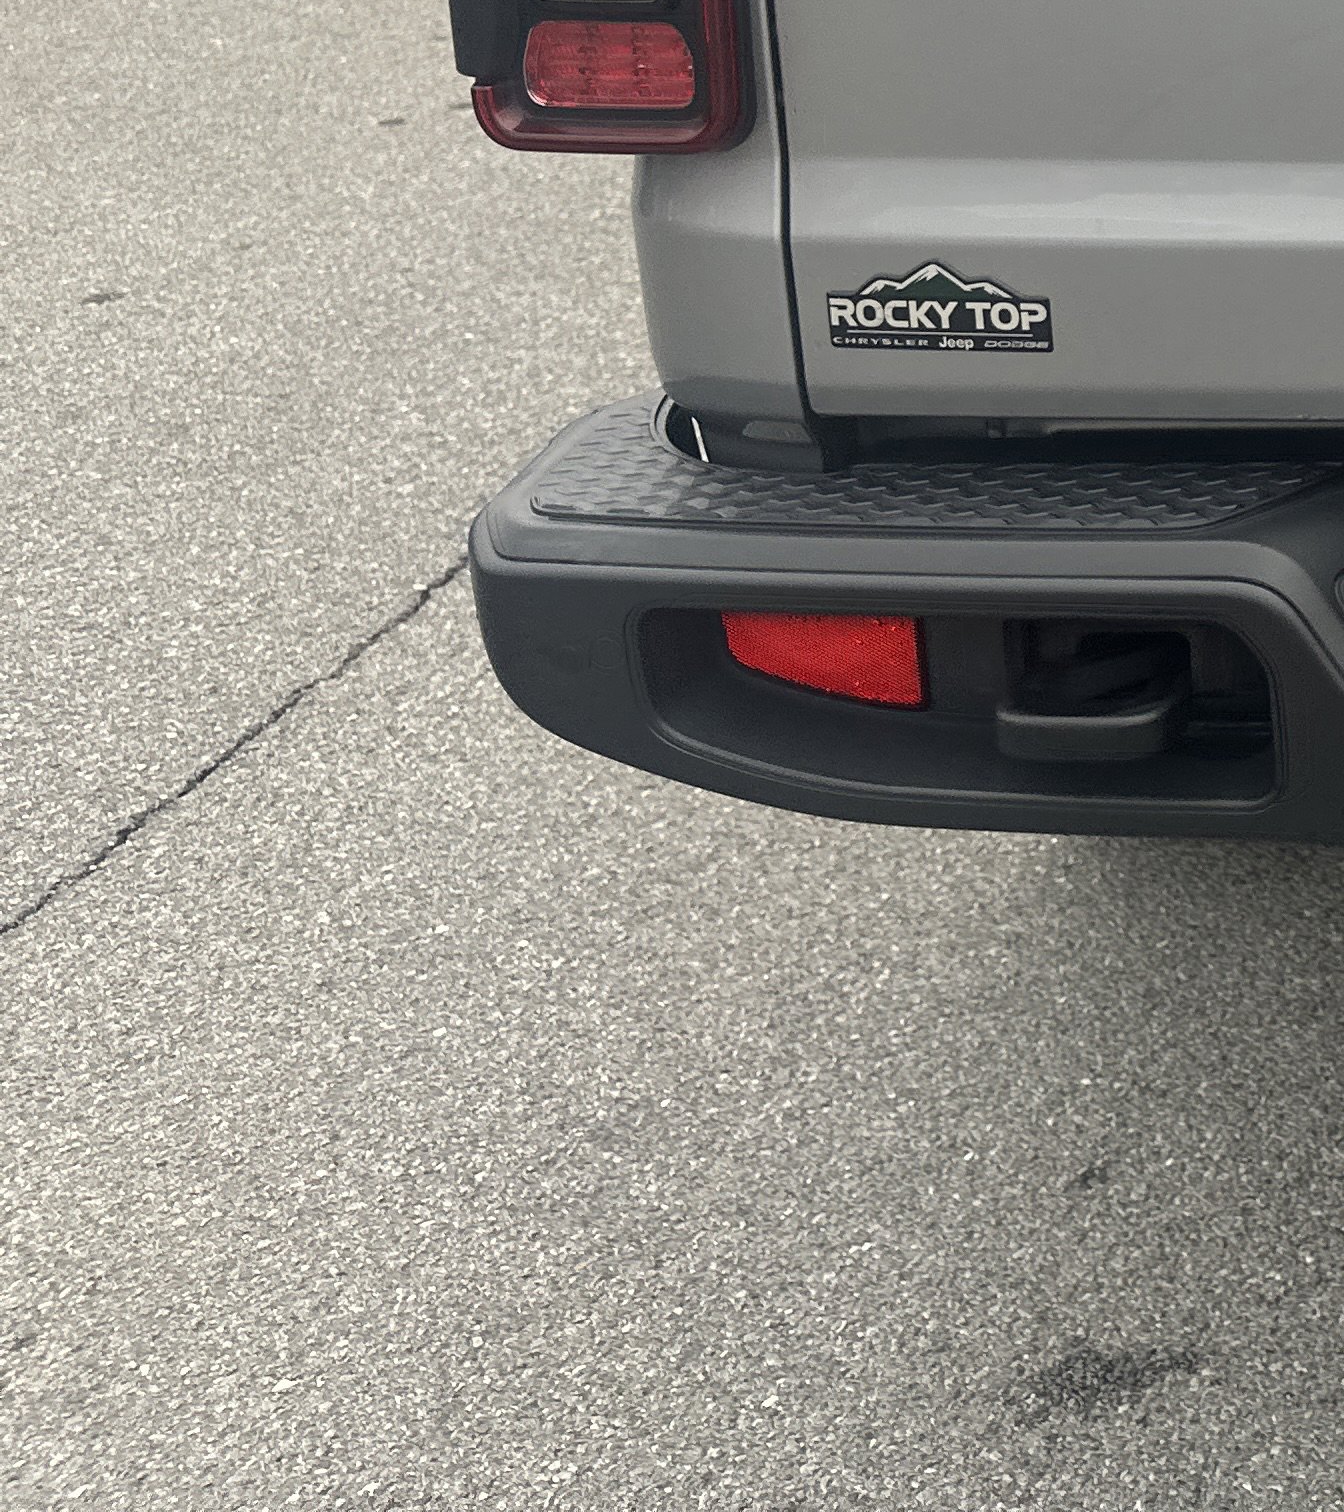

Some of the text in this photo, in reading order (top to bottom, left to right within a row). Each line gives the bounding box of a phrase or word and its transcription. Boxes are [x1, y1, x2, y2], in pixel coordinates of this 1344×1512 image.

[829, 298, 1048, 330] ROCKY TOP
[833, 336, 1049, 350] CHRYSLER Jeep DODGE
